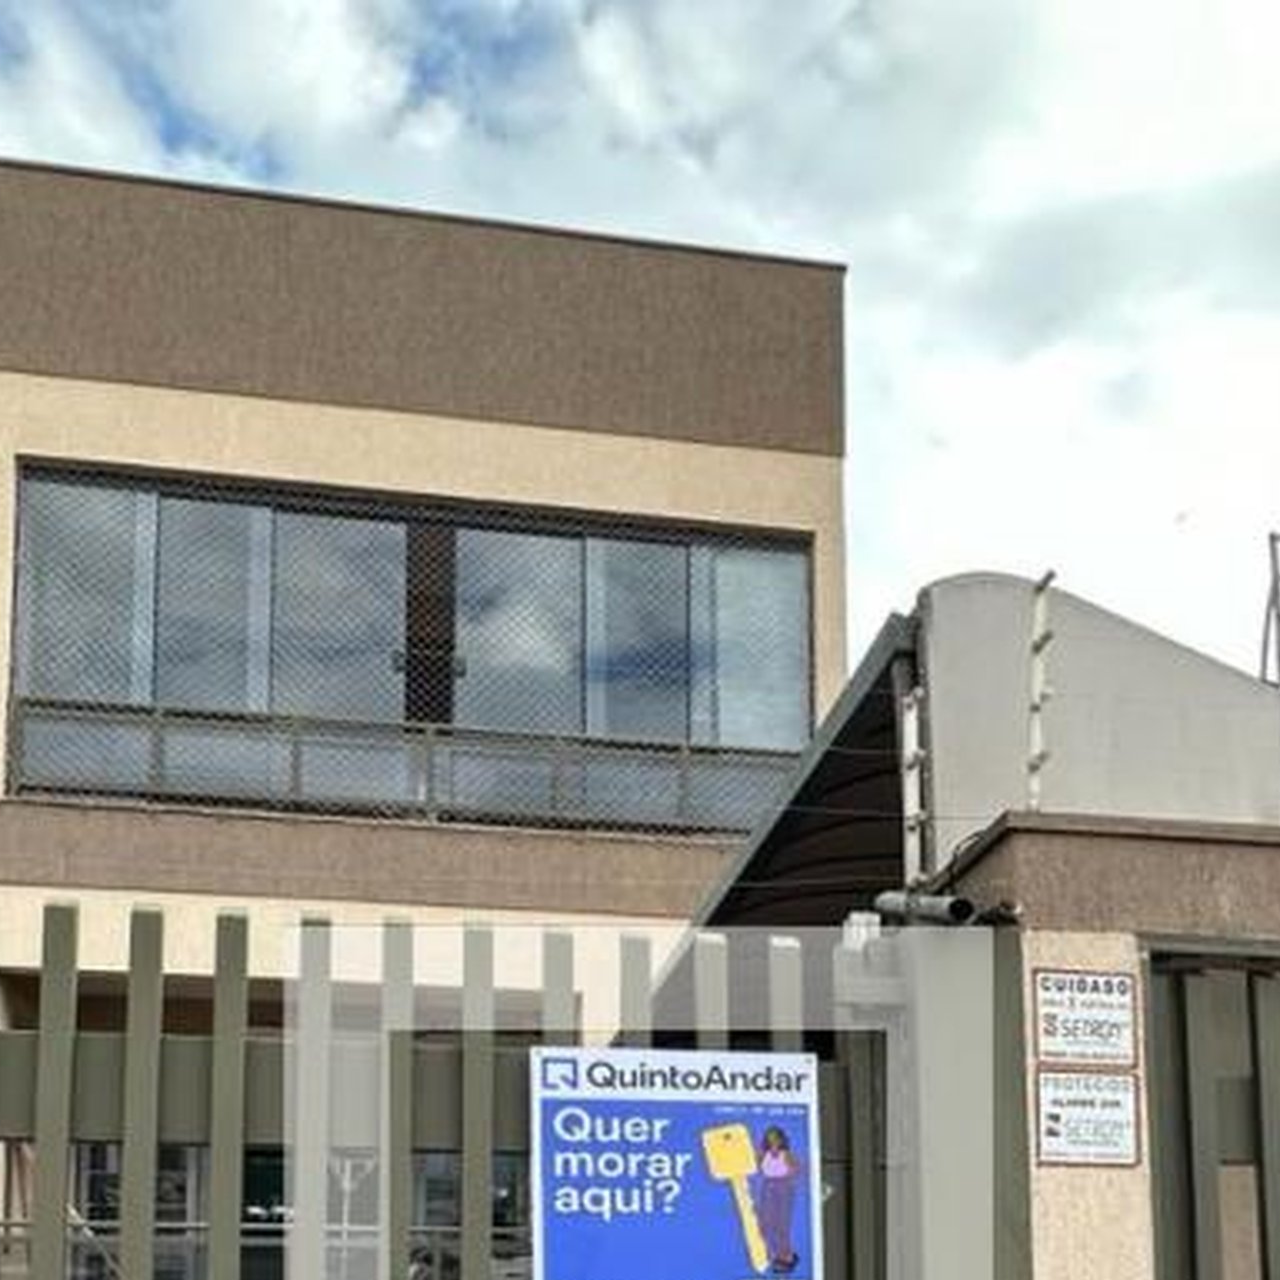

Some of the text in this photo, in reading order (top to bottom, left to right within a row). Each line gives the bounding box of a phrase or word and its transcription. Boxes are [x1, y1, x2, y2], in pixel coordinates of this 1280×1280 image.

[586, 1061, 808, 1092] QuintoAndar
[553, 1107, 668, 1143] Quer
[554, 1151, 692, 1178] morar
[554, 1180, 681, 1222] aqui?
